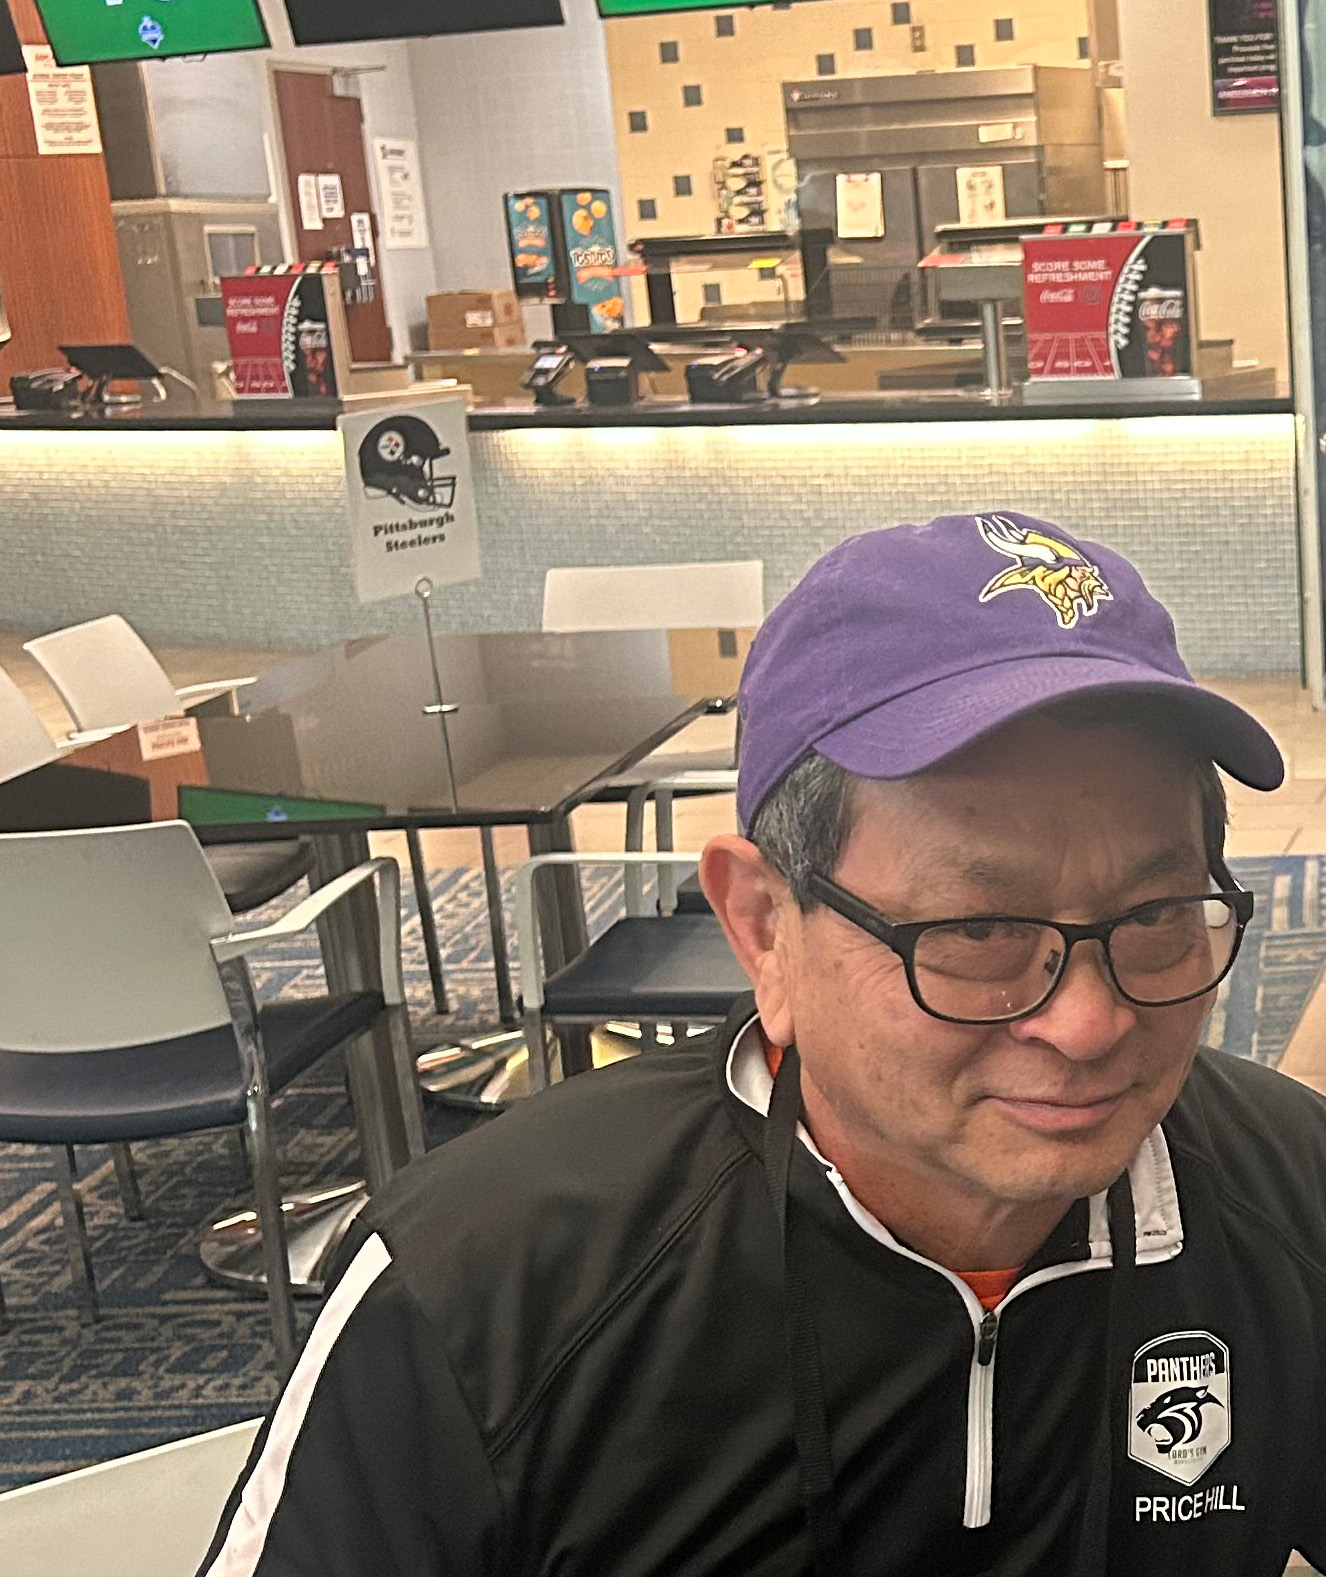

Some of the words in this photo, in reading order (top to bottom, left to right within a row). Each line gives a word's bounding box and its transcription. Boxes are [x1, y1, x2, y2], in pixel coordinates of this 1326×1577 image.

[1031, 262, 1069, 272] SCORE
[1073, 260, 1106, 270] SOME
[372, 511, 455, 538] Pittsburgh
[386, 532, 446, 552] Steelers
[1147, 1352, 1216, 1383] PANTHERS
[1135, 1492, 1204, 1522] PRICE
[1204, 1485, 1246, 1514] HILL
